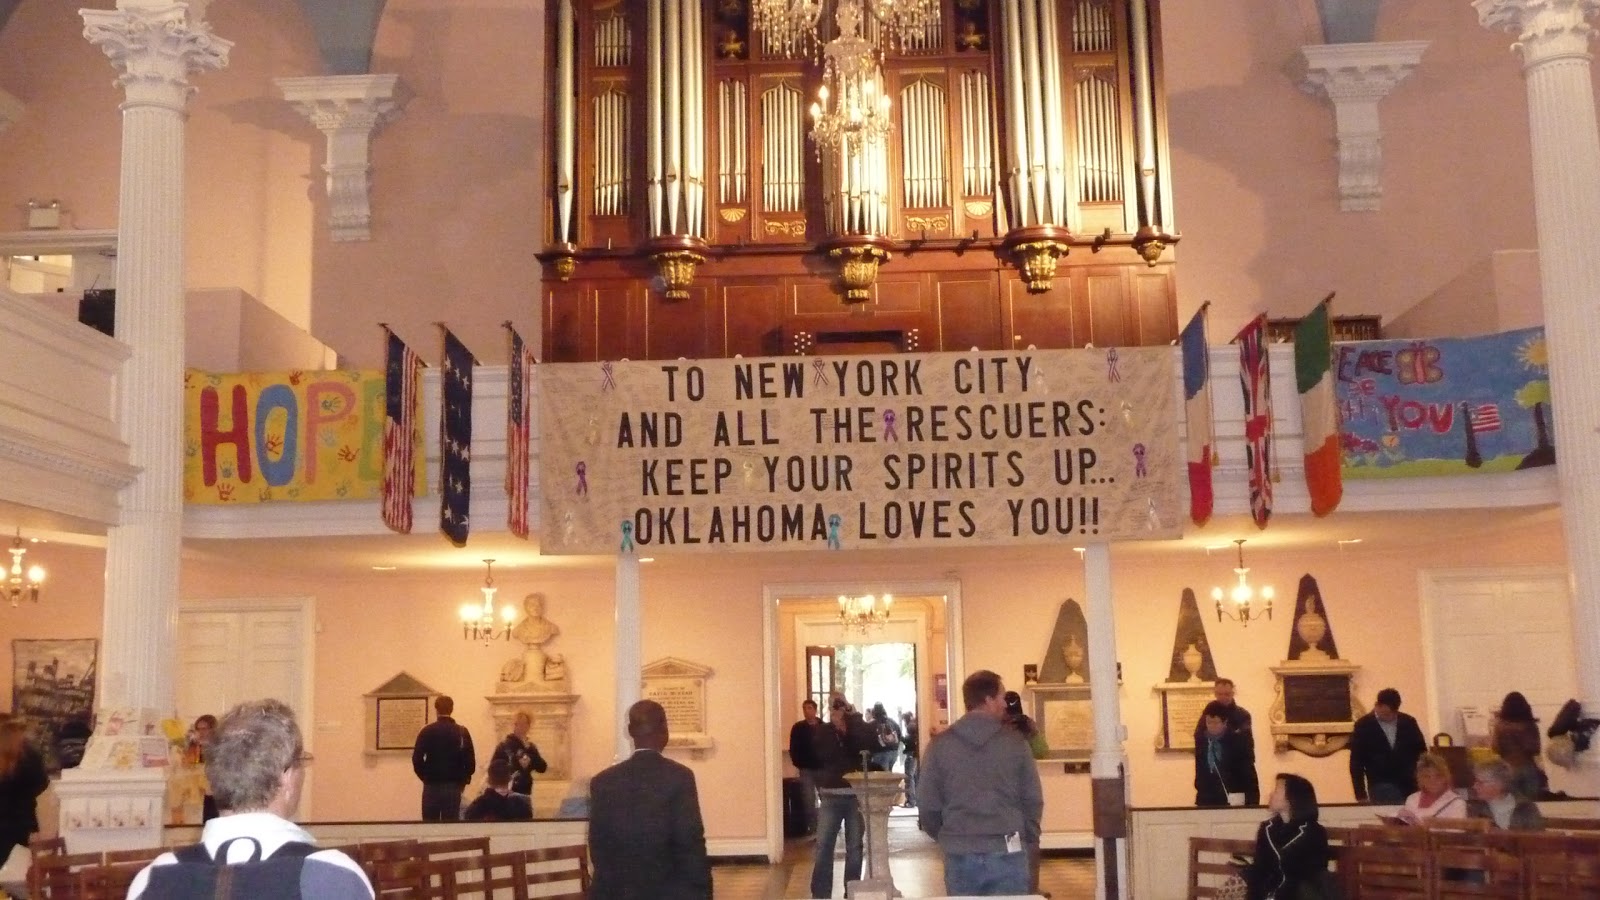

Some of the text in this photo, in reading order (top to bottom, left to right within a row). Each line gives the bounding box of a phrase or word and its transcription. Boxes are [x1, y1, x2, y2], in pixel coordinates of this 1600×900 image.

[662, 356, 1033, 401] TO NEW YORK CITY
[617, 399, 1106, 448] AND ALL THE RESCUERS:
[1380, 394, 1453, 434] YOU
[642, 447, 1115, 496] KEEP YOUR SPIRITS UP...
[634, 497, 1099, 546] OKLAHOMA LOVES YOU!!
